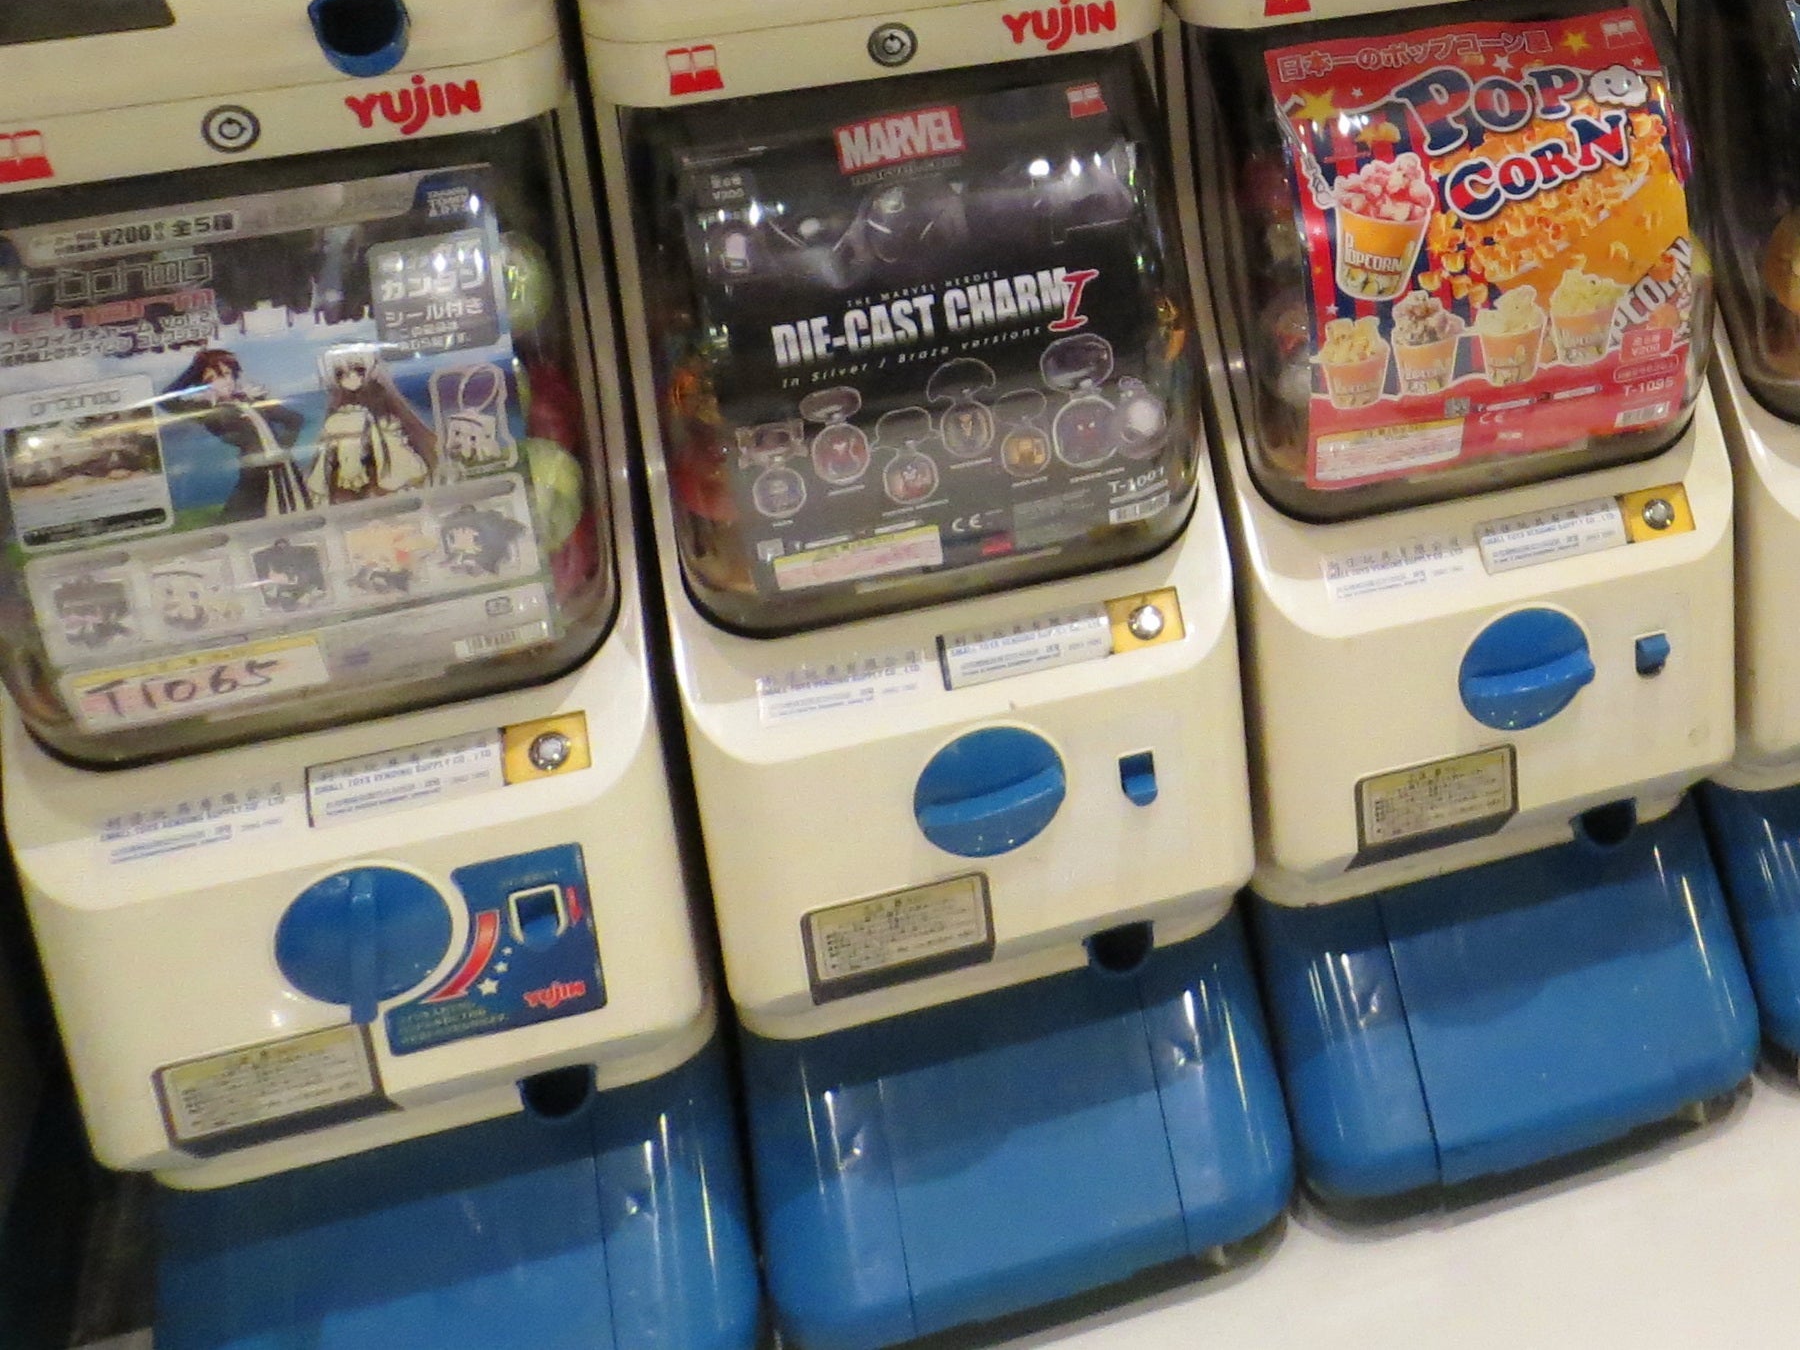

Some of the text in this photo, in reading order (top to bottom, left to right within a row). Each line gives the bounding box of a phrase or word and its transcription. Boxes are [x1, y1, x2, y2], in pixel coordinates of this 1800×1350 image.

[838, 110, 963, 171] MARVEL
[1392, 65, 1585, 156] POP
[1444, 109, 1632, 222] CORN
[770, 293, 936, 369] DIE-CAST
[942, 266, 1072, 333] CHARM
